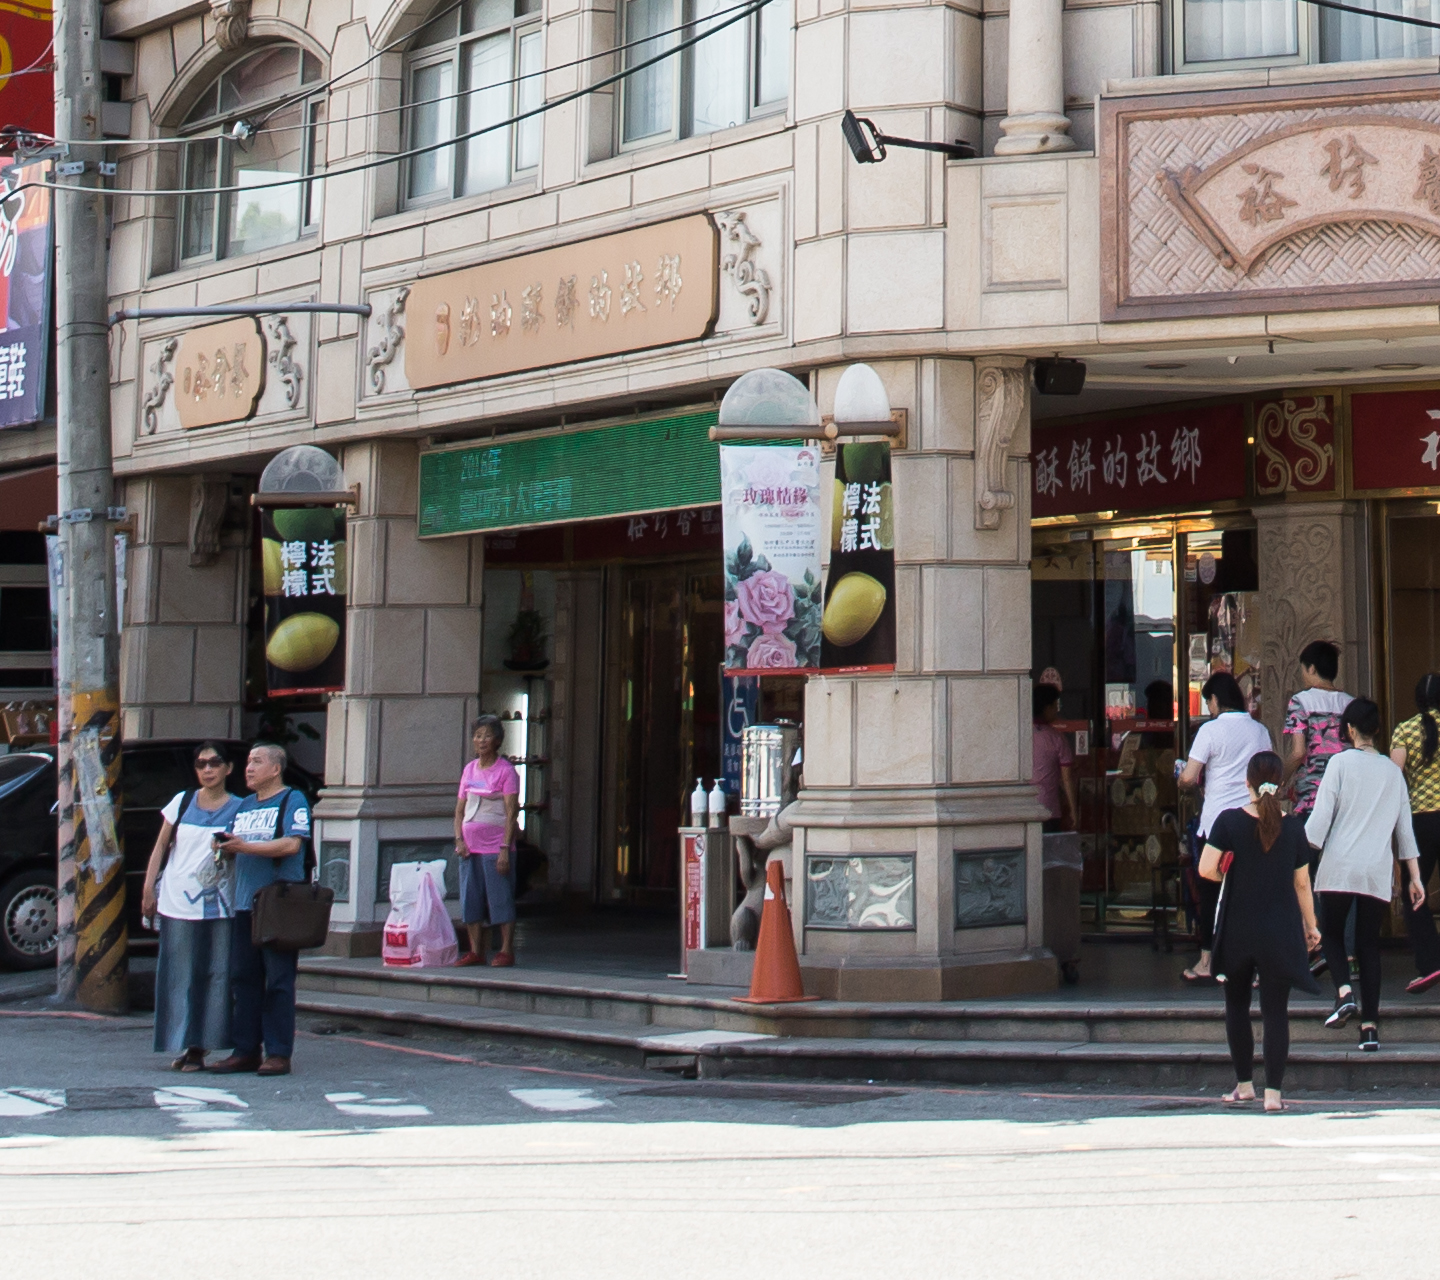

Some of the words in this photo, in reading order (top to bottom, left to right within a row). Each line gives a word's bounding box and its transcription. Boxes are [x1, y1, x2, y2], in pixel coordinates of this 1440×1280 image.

[1034, 426, 1203, 498] 酥餅的故鄉
[743, 486, 809, 506] 玫瑰情緣
[840, 482, 861, 554] 檸檬
[862, 480, 882, 551] 法式
[280, 540, 308, 598] 檸檬
[310, 539, 336, 597] 法式
